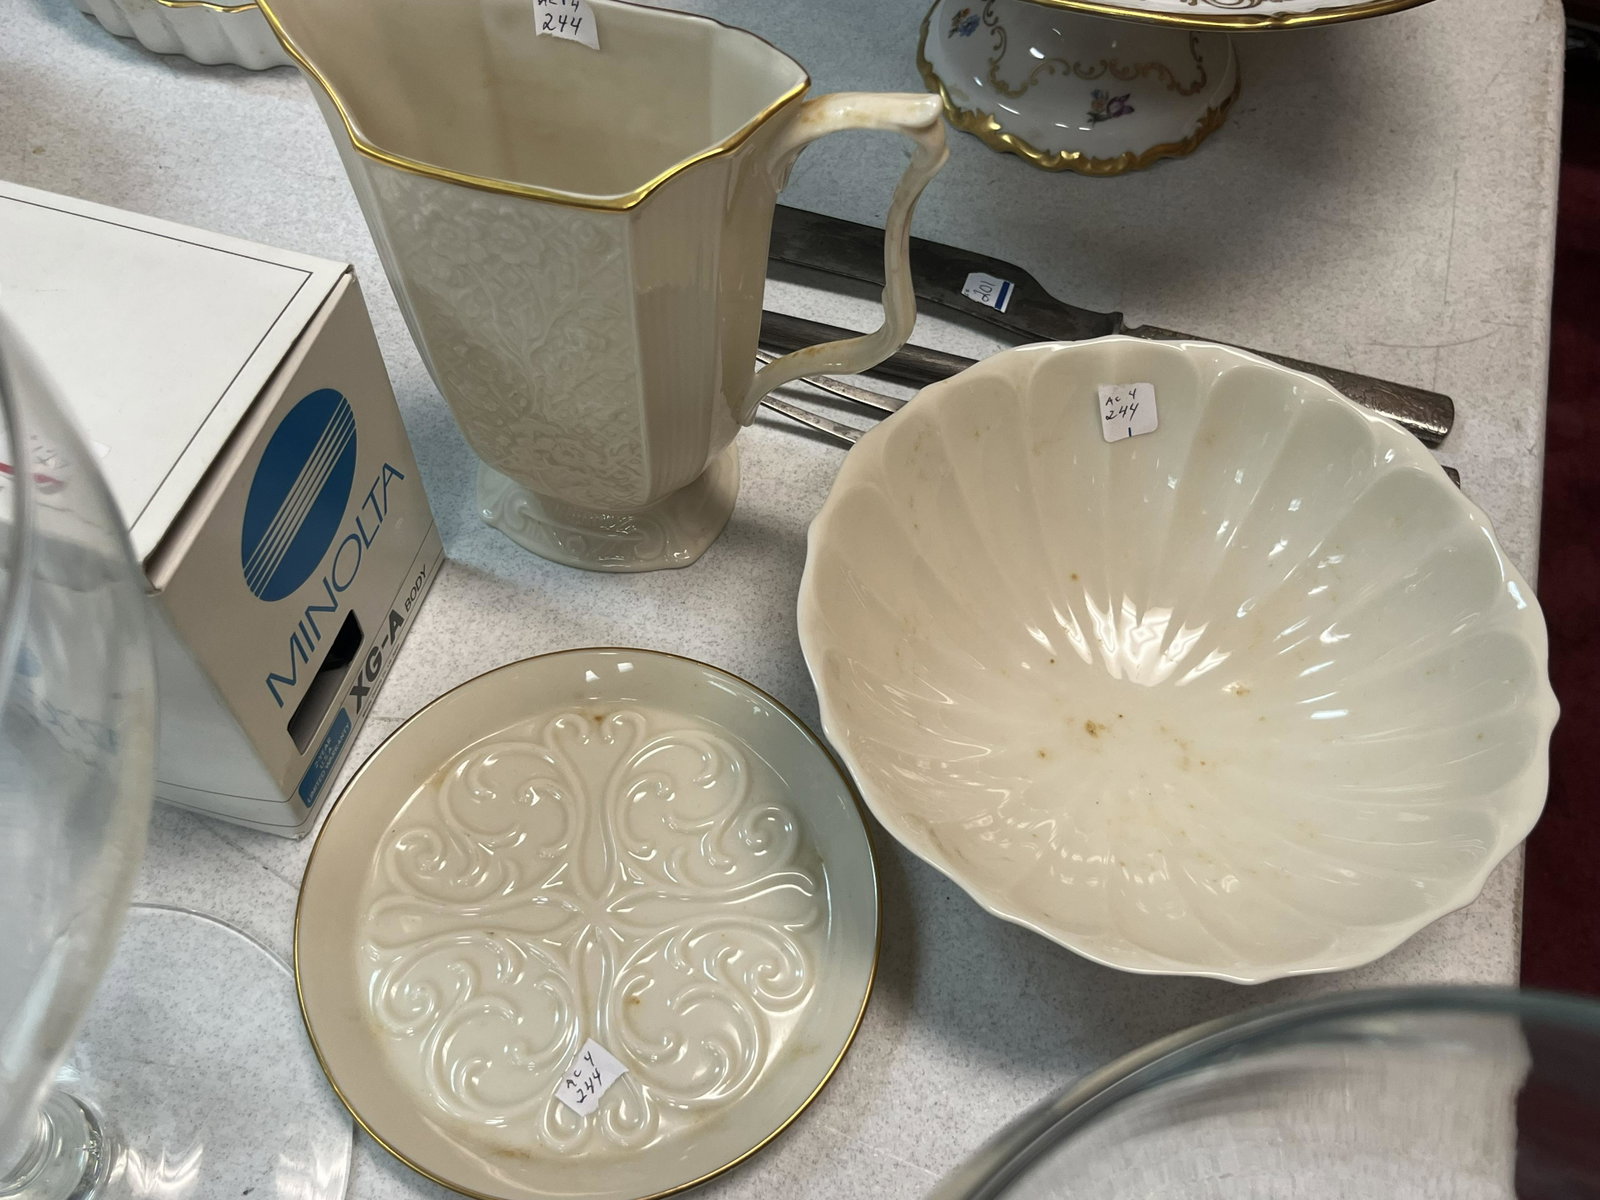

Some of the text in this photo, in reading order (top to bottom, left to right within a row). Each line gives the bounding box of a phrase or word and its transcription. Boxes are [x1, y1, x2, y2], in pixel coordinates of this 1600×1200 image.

[543, 13, 582, 35] 244
[1105, 402, 1139, 421] 244
[266, 462, 405, 709] MINOLTA
[350, 609, 405, 715] XG-A
[404, 564, 427, 613] BODY
[306, 722, 351, 804] LIMITED WARRANTY
[584, 1050, 595, 1068] 4
[576, 1067, 602, 1104] 244
